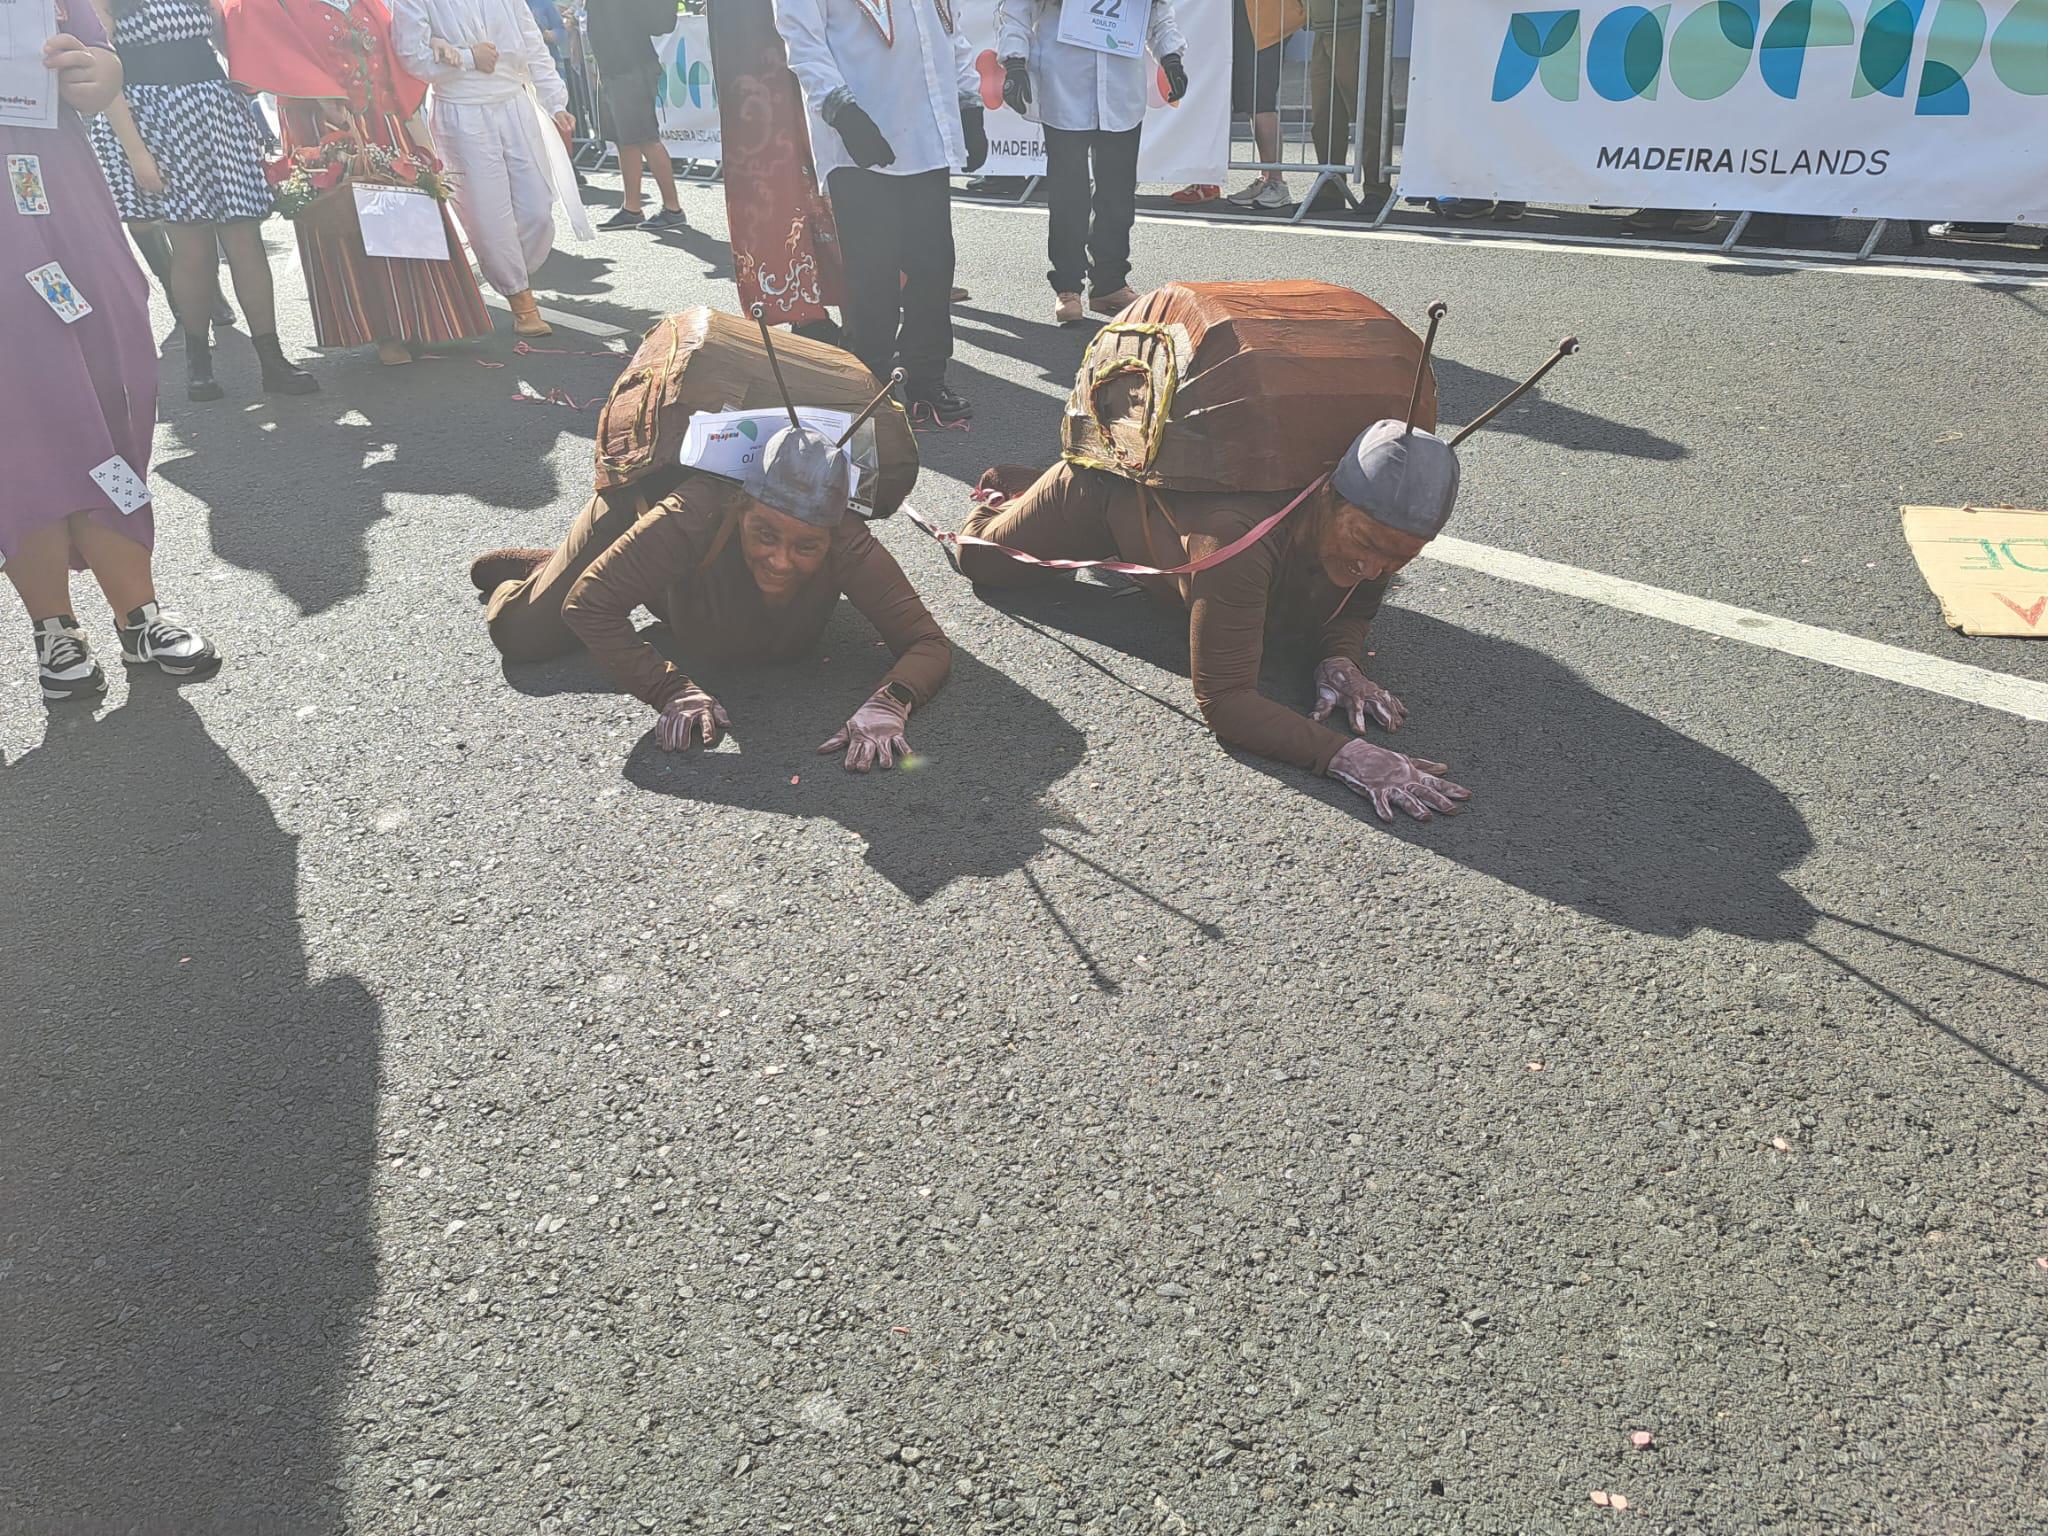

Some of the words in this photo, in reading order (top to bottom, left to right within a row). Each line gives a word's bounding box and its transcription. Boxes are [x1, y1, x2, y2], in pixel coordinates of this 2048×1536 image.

[1090, 0, 1122, 18] 22
[1091, 18, 1117, 29] ADULTO
[991, 139, 1048, 157] MADEIRA
[1596, 146, 1734, 173] MADEIRA
[1739, 148, 1890, 176] ISLANDS
